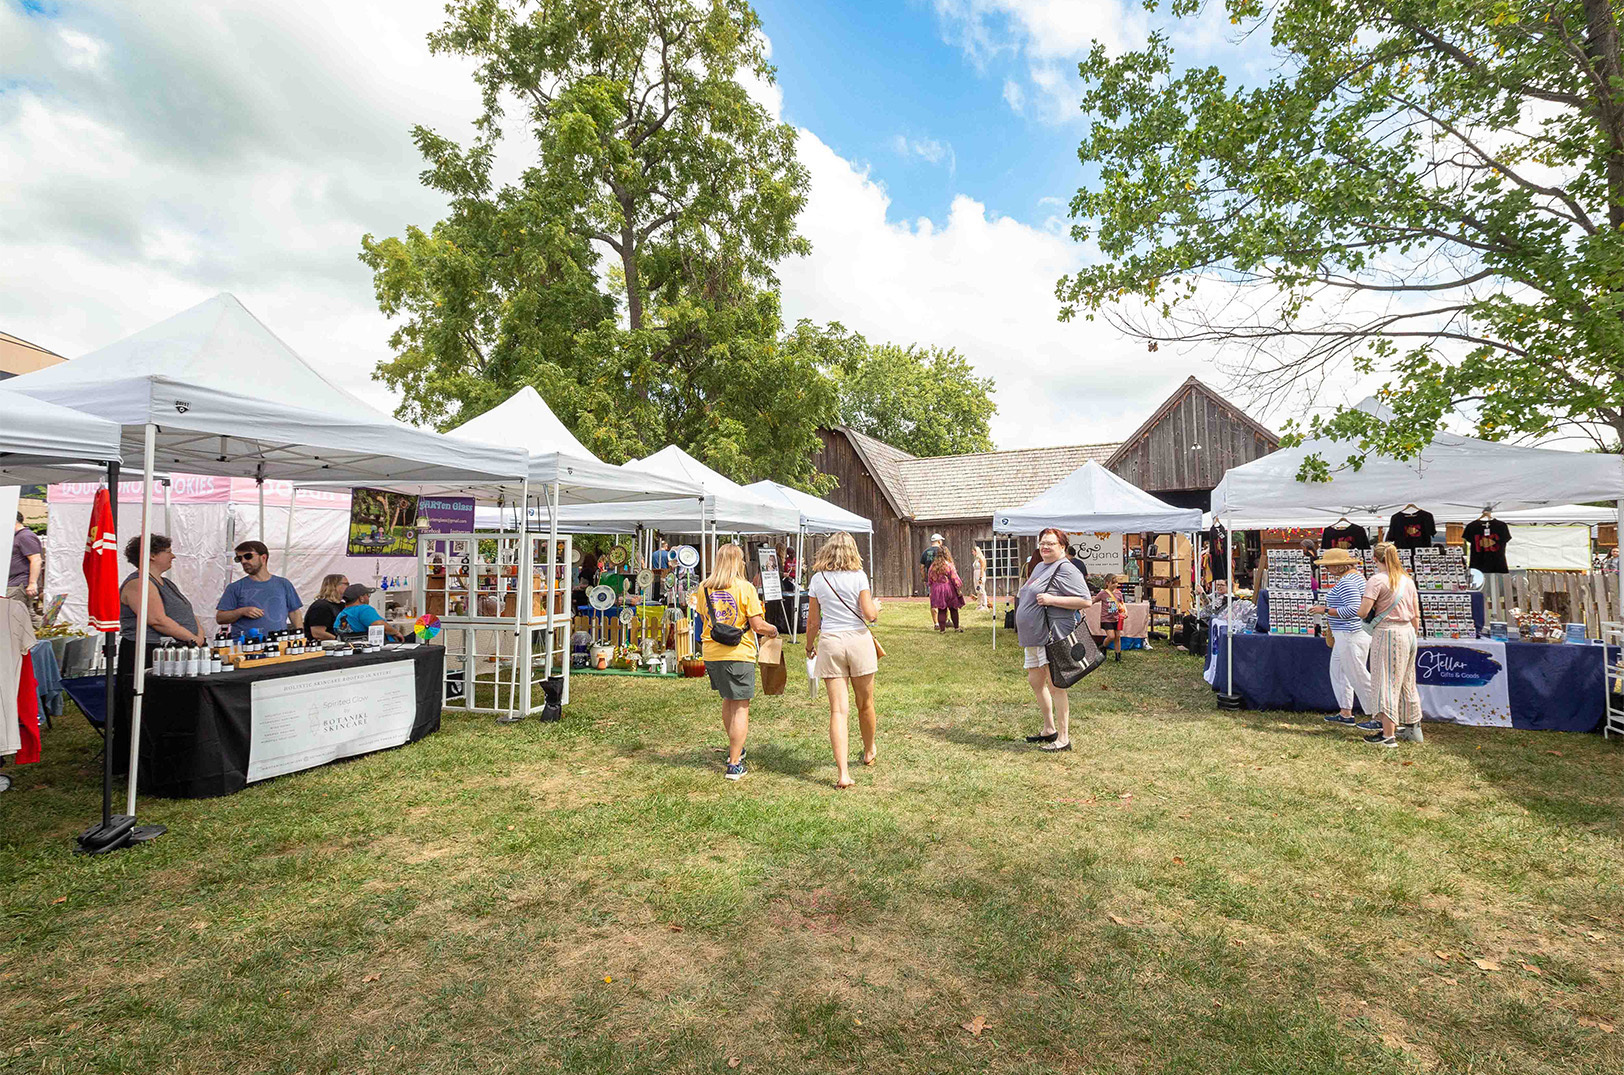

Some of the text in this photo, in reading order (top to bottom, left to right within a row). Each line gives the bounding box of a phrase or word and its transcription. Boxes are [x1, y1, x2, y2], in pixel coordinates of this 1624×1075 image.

[452, 502, 473, 511] Glass
[1418, 651, 1467, 678] Stellar
[323, 695, 369, 709] Spirited Glow
[323, 719, 368, 733] SKINCARE
